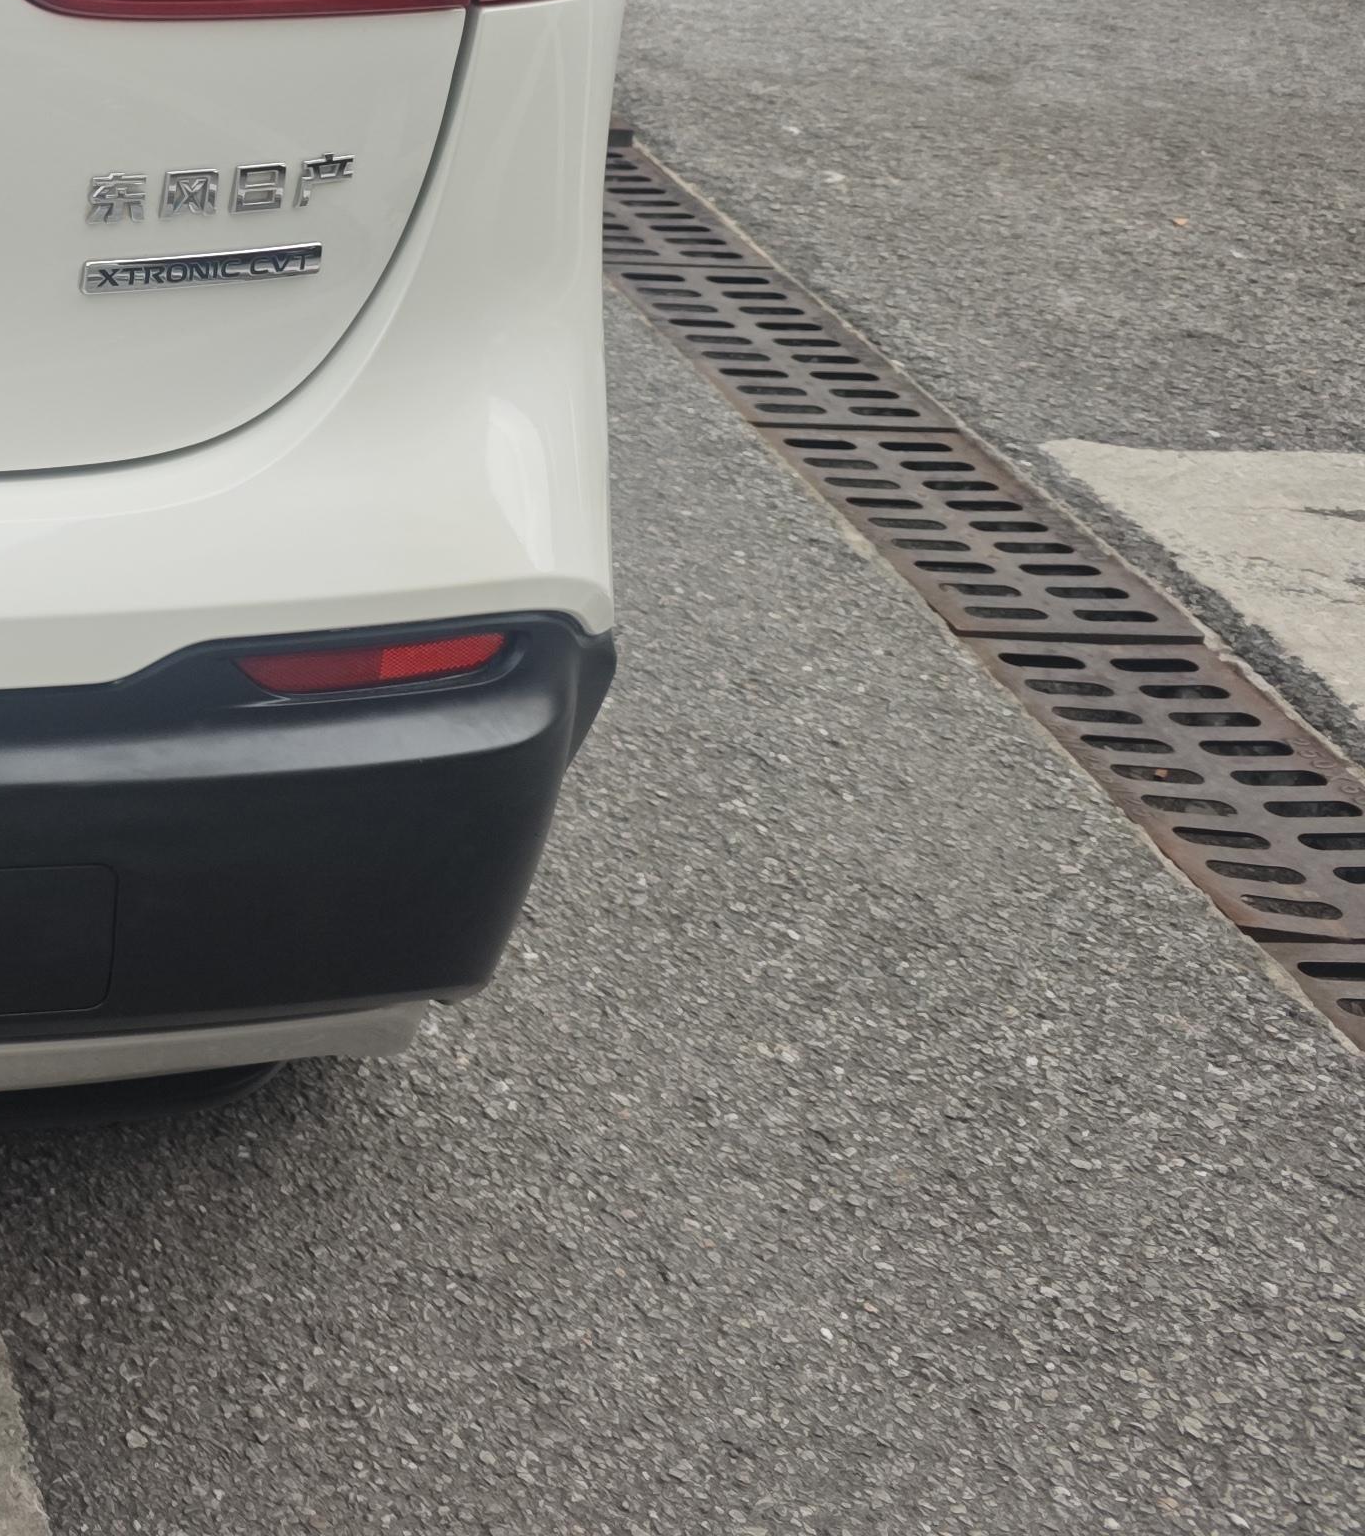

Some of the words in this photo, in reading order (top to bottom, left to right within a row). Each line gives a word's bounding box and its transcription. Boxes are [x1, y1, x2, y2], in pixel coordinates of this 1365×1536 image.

[85, 152, 356, 225] 东风日产
[97, 259, 241, 288] XTRONIC
[250, 253, 314, 276] CVT
